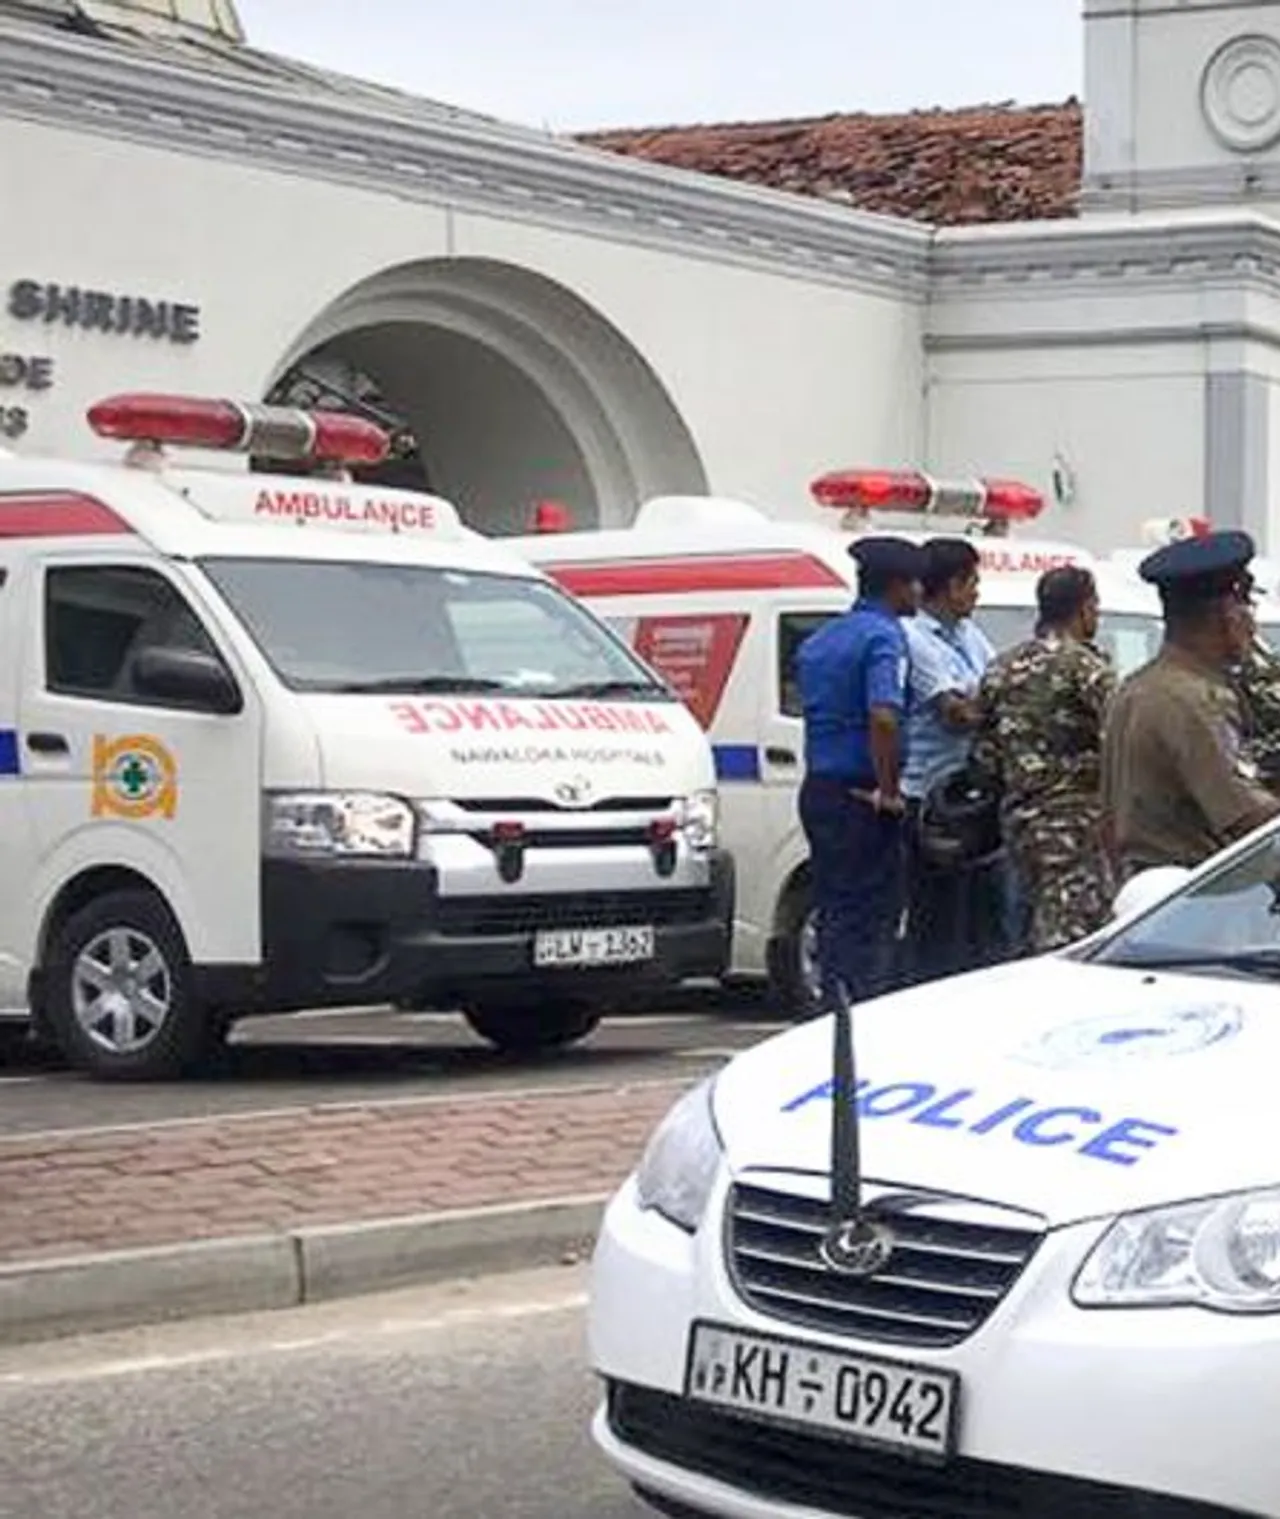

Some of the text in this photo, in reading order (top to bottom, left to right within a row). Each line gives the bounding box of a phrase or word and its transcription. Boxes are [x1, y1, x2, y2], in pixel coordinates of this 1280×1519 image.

[8, 279, 200, 344] SHRINE
[255, 489, 435, 529] AMBULANCE
[780, 1076, 1179, 1165] POLICE
